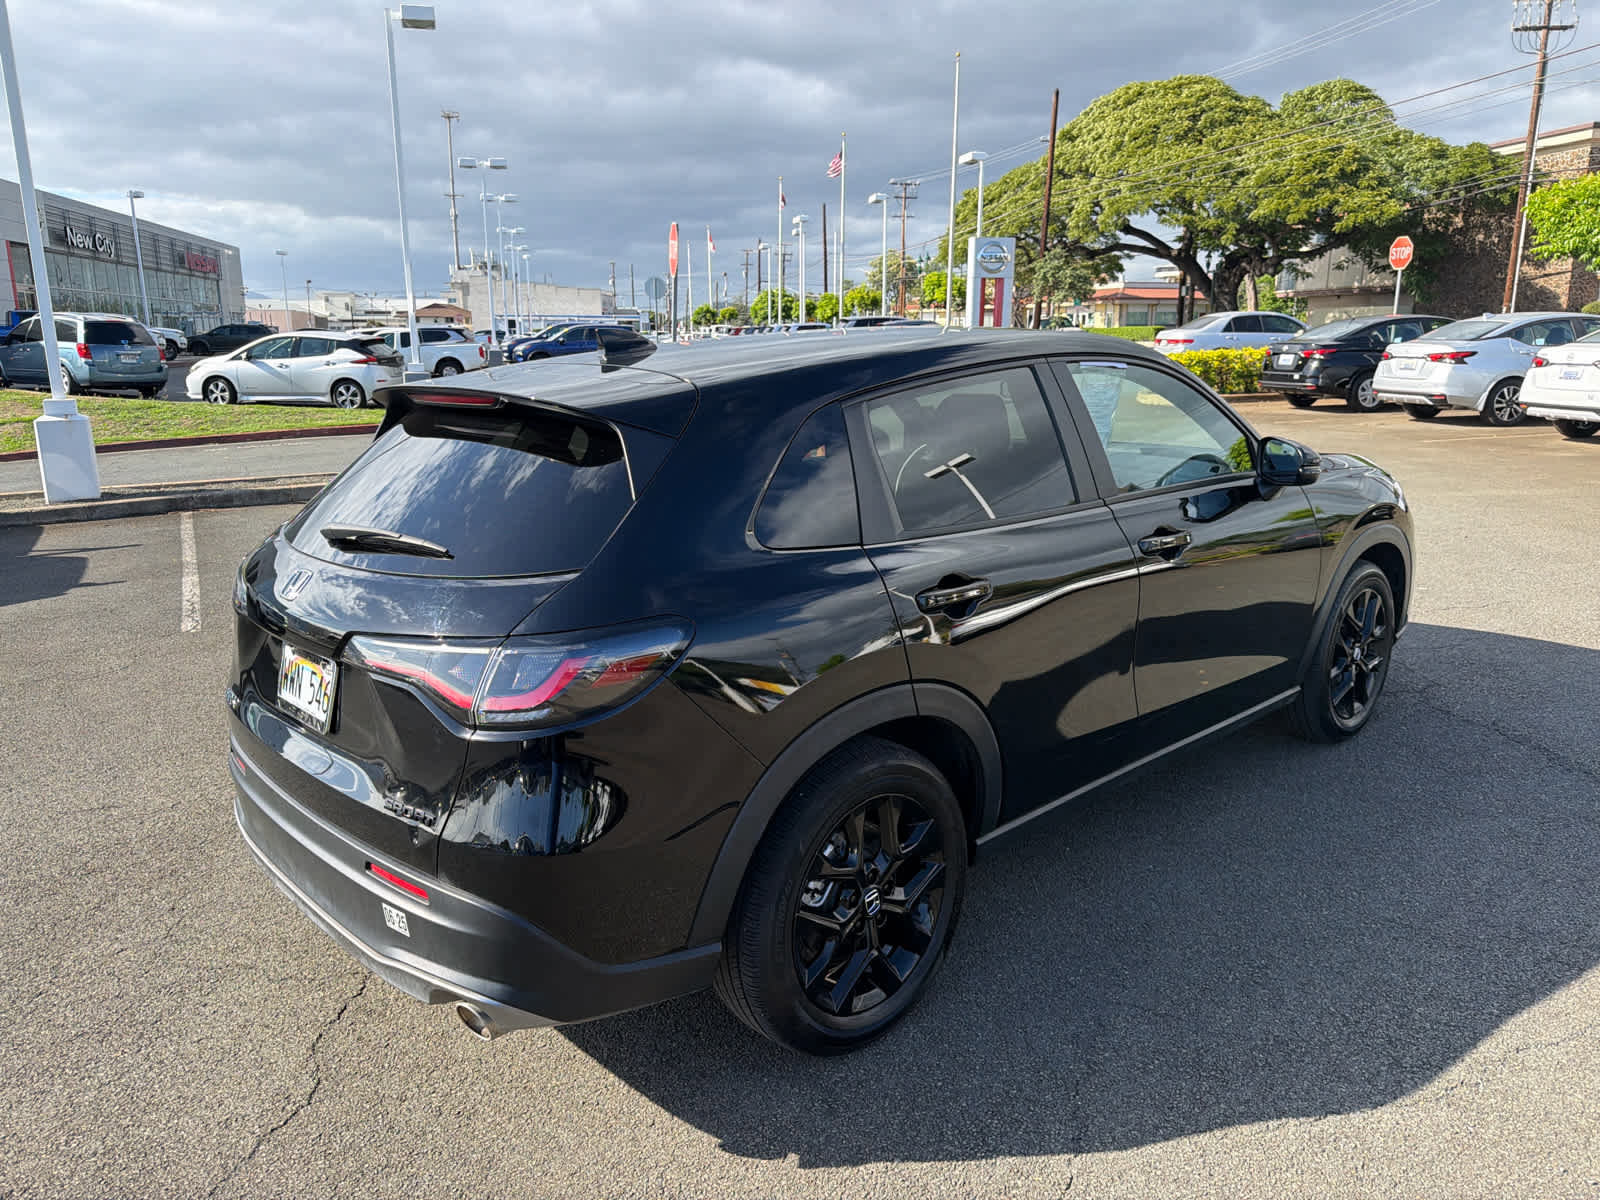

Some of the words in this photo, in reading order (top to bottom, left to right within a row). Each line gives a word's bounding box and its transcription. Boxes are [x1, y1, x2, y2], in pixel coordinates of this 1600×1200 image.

[65, 226, 93, 249] New
[95, 233, 115, 258] City
[1391, 246, 1411, 260] STOP
[309, 671, 330, 713] 546
